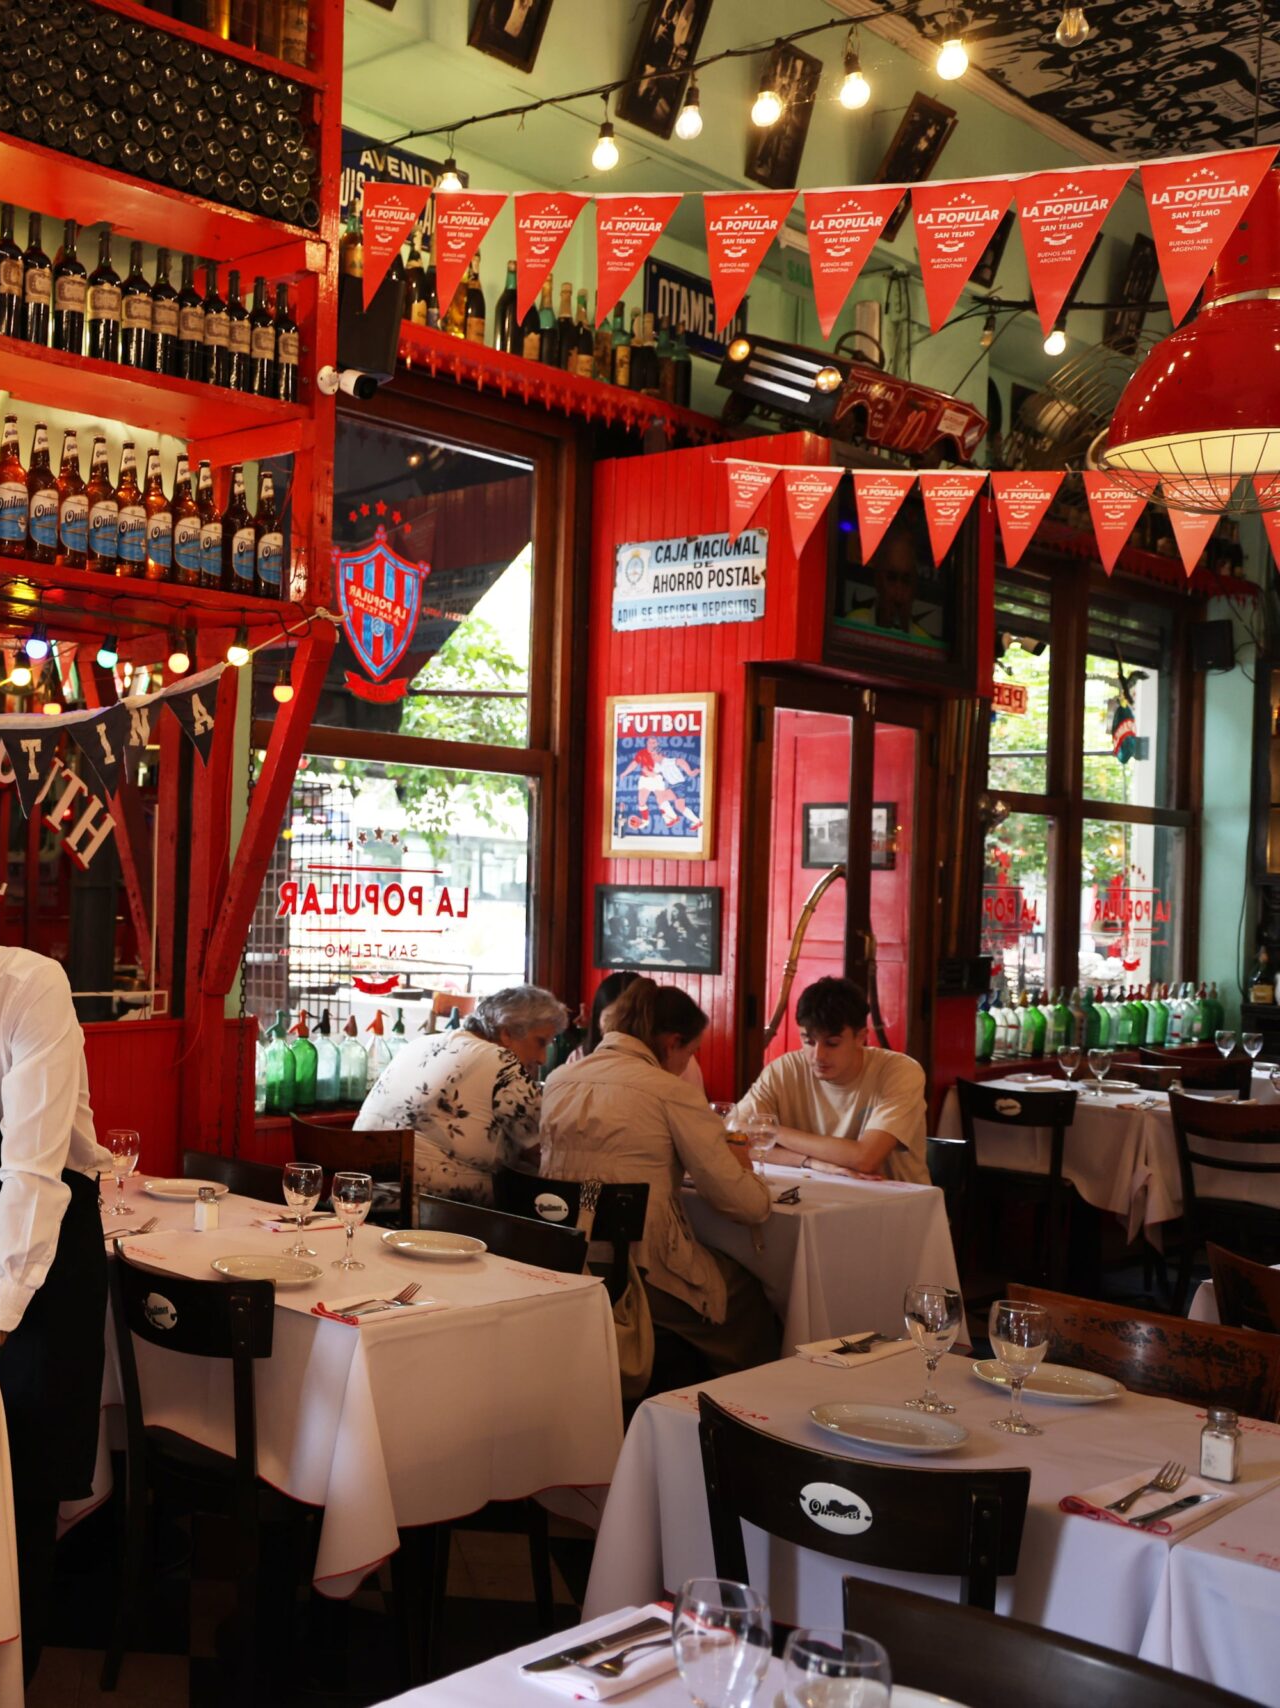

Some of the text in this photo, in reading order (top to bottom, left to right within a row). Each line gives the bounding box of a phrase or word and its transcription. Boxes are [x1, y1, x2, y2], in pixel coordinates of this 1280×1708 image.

[1152, 185, 1250, 205] LA POPULAR
[1022, 199, 1109, 218] LA POPULAR
[1171, 209, 1220, 219] SAN TELMO
[366, 209, 416, 221] LA POPULAR
[438, 215, 490, 226] LA POPULAR
[918, 210, 1000, 224] LA POPULAR
[519, 219, 573, 229] LA POPULAR
[600, 221, 662, 232] LA POPULAR
[709, 220, 778, 231] LA POPULAR
[810, 216, 883, 230] LA POPULAR
[1058, 222, 1083, 230] TELMO
[869, 489, 904, 497] POPULAR
[998, 492, 1051, 500] LA POPULAR
[655, 535, 760, 563] CAJA NACIONAL
[694, 561, 714, 569] DE
[653, 566, 761, 594] AHORRO POSTAL
[622, 713, 700, 733] FUTBOL
